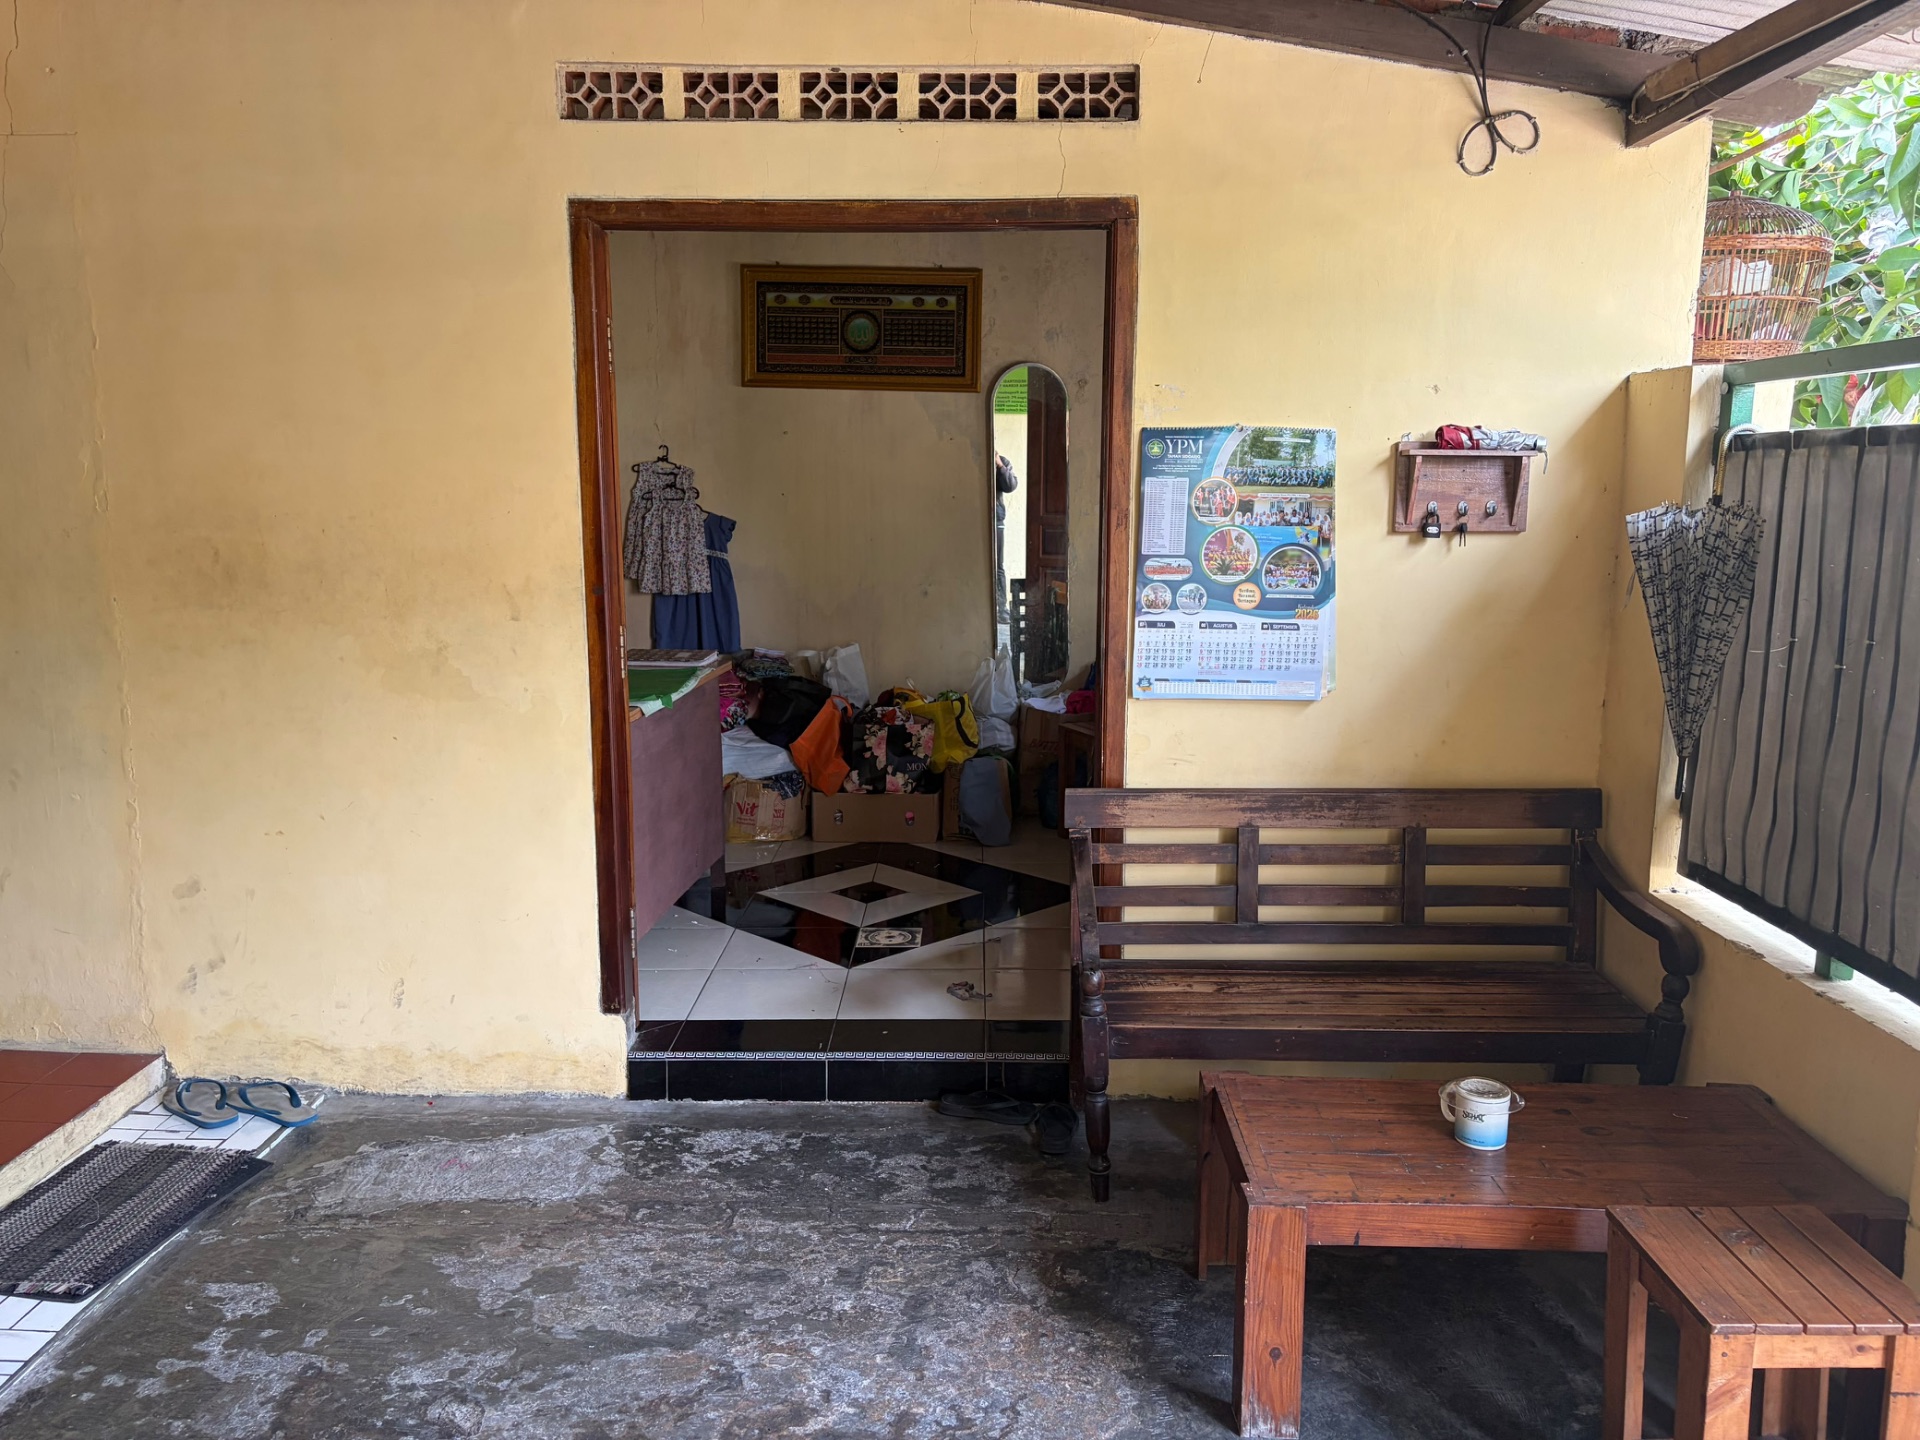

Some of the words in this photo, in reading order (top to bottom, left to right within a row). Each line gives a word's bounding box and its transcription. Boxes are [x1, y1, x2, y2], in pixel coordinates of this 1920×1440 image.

[1166, 439, 1204, 454] YPM
[1296, 609, 1319, 620] 2026
[736, 801, 759, 816] Vit
